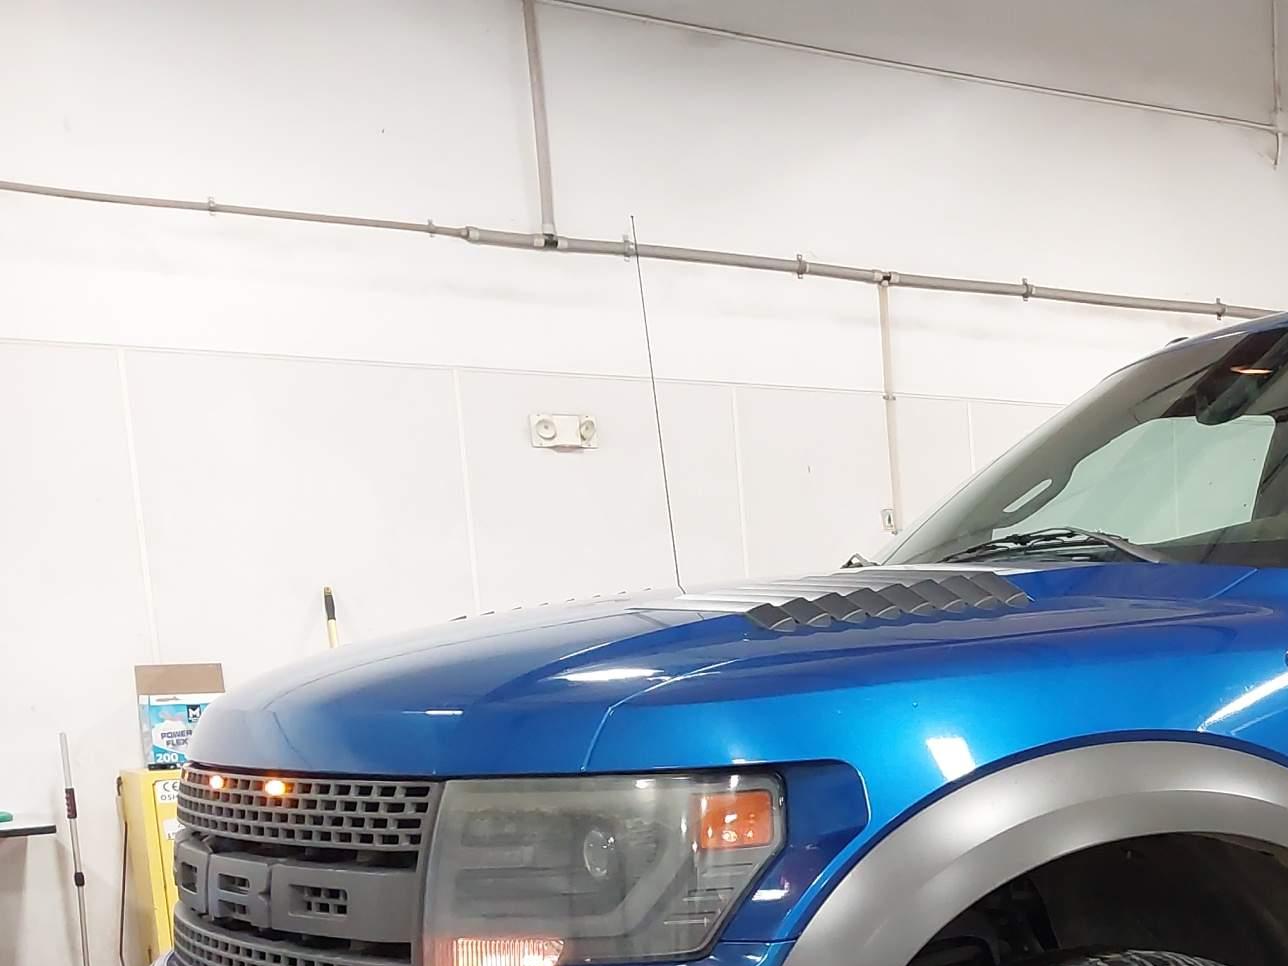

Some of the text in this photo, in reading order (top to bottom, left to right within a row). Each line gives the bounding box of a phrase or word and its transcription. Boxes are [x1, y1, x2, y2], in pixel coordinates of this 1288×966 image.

[160, 728, 193, 740] POWER
[165, 738, 189, 747] FLEX
[155, 752, 179, 763] 200
